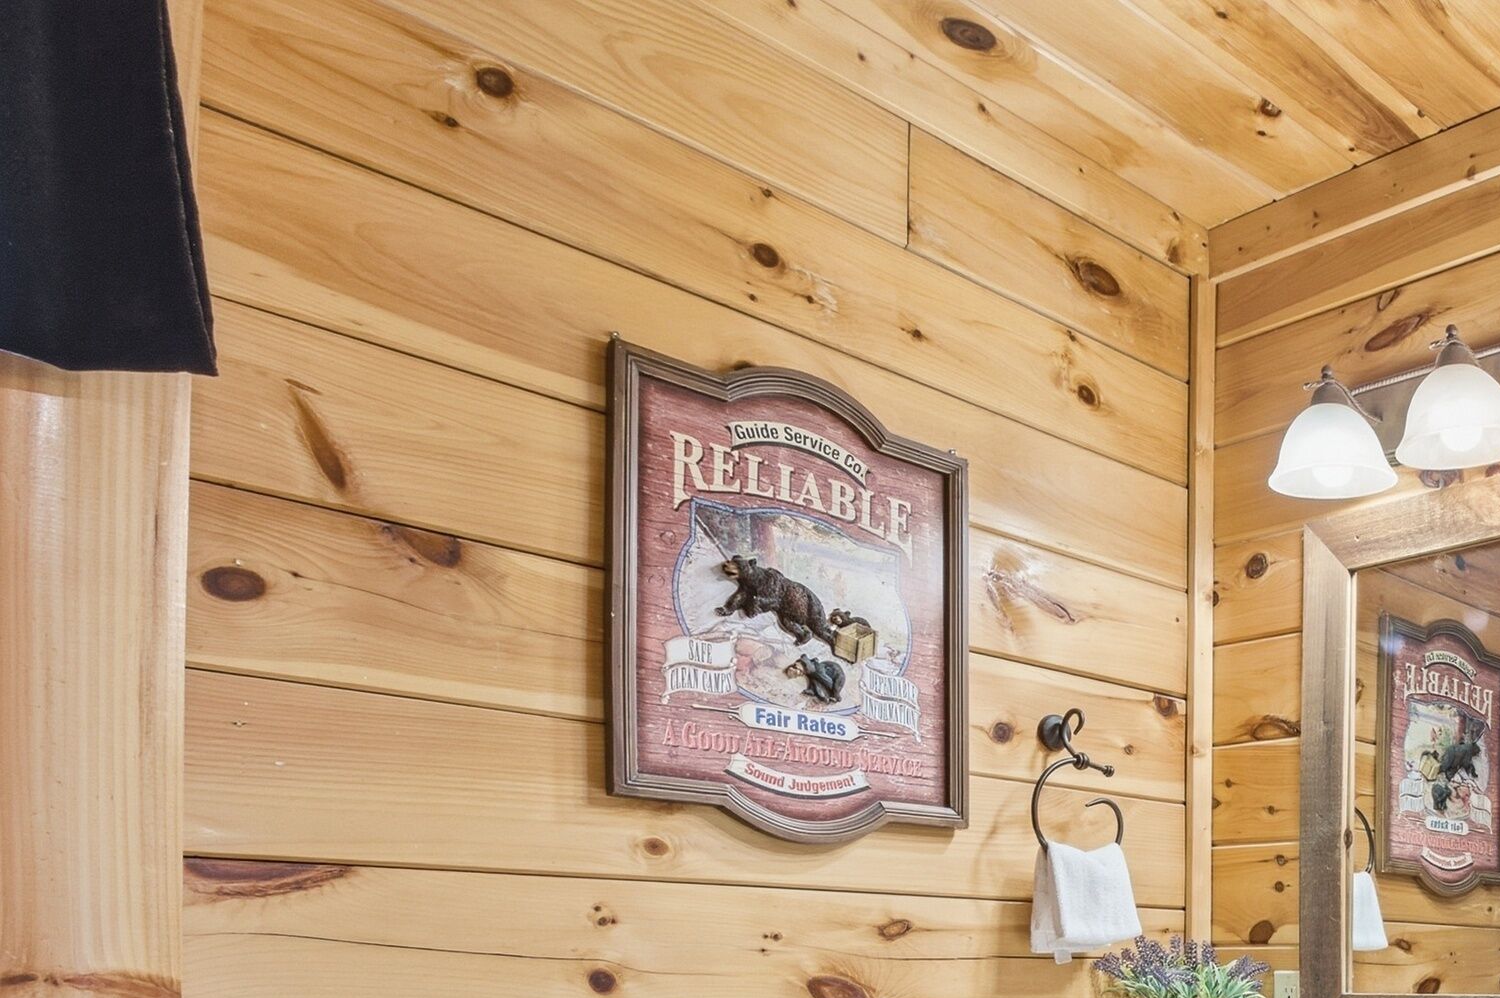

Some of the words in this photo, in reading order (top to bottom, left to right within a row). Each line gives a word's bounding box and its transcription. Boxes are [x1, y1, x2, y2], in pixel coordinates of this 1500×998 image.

[734, 423, 779, 441] Guide
[784, 426, 840, 461] Service
[844, 453, 865, 478] Co.
[669, 430, 913, 568] RELIABLE
[688, 639, 713, 664] SAFE
[670, 667, 699, 691] CLEAN
[702, 671, 732, 693] CAMPS
[755, 707, 791, 728] Fair
[797, 713, 847, 736] Rates
[662, 719, 680, 748] A
[681, 721, 741, 754] GOOD
[859, 746, 923, 779] SERVICE
[744, 762, 786, 788] Sound
[788, 775, 856, 794] Judgement
